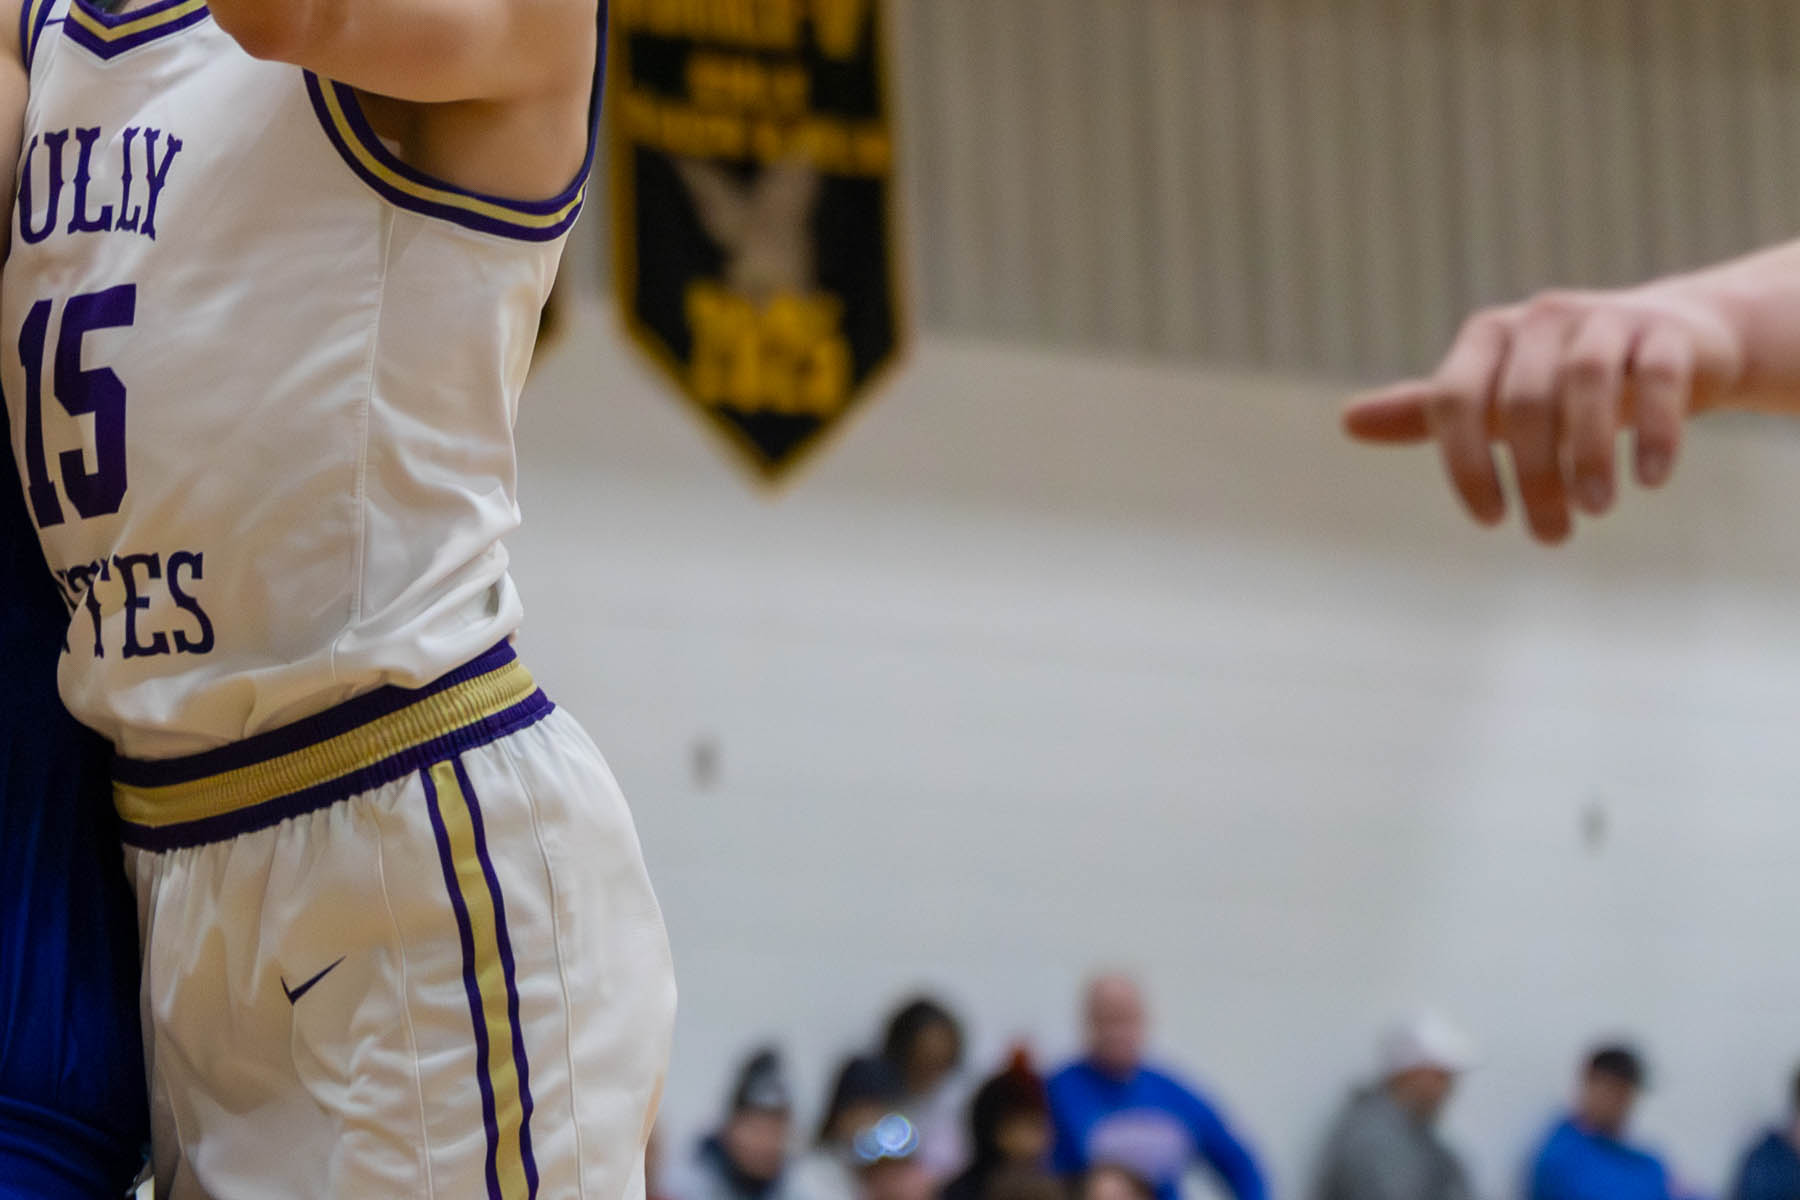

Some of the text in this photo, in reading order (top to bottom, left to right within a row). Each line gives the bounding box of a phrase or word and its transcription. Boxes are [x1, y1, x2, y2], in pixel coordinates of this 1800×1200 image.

[18, 126, 184, 246] ULLY
[18, 283, 138, 530] 15
[56, 552, 215, 660] TES
